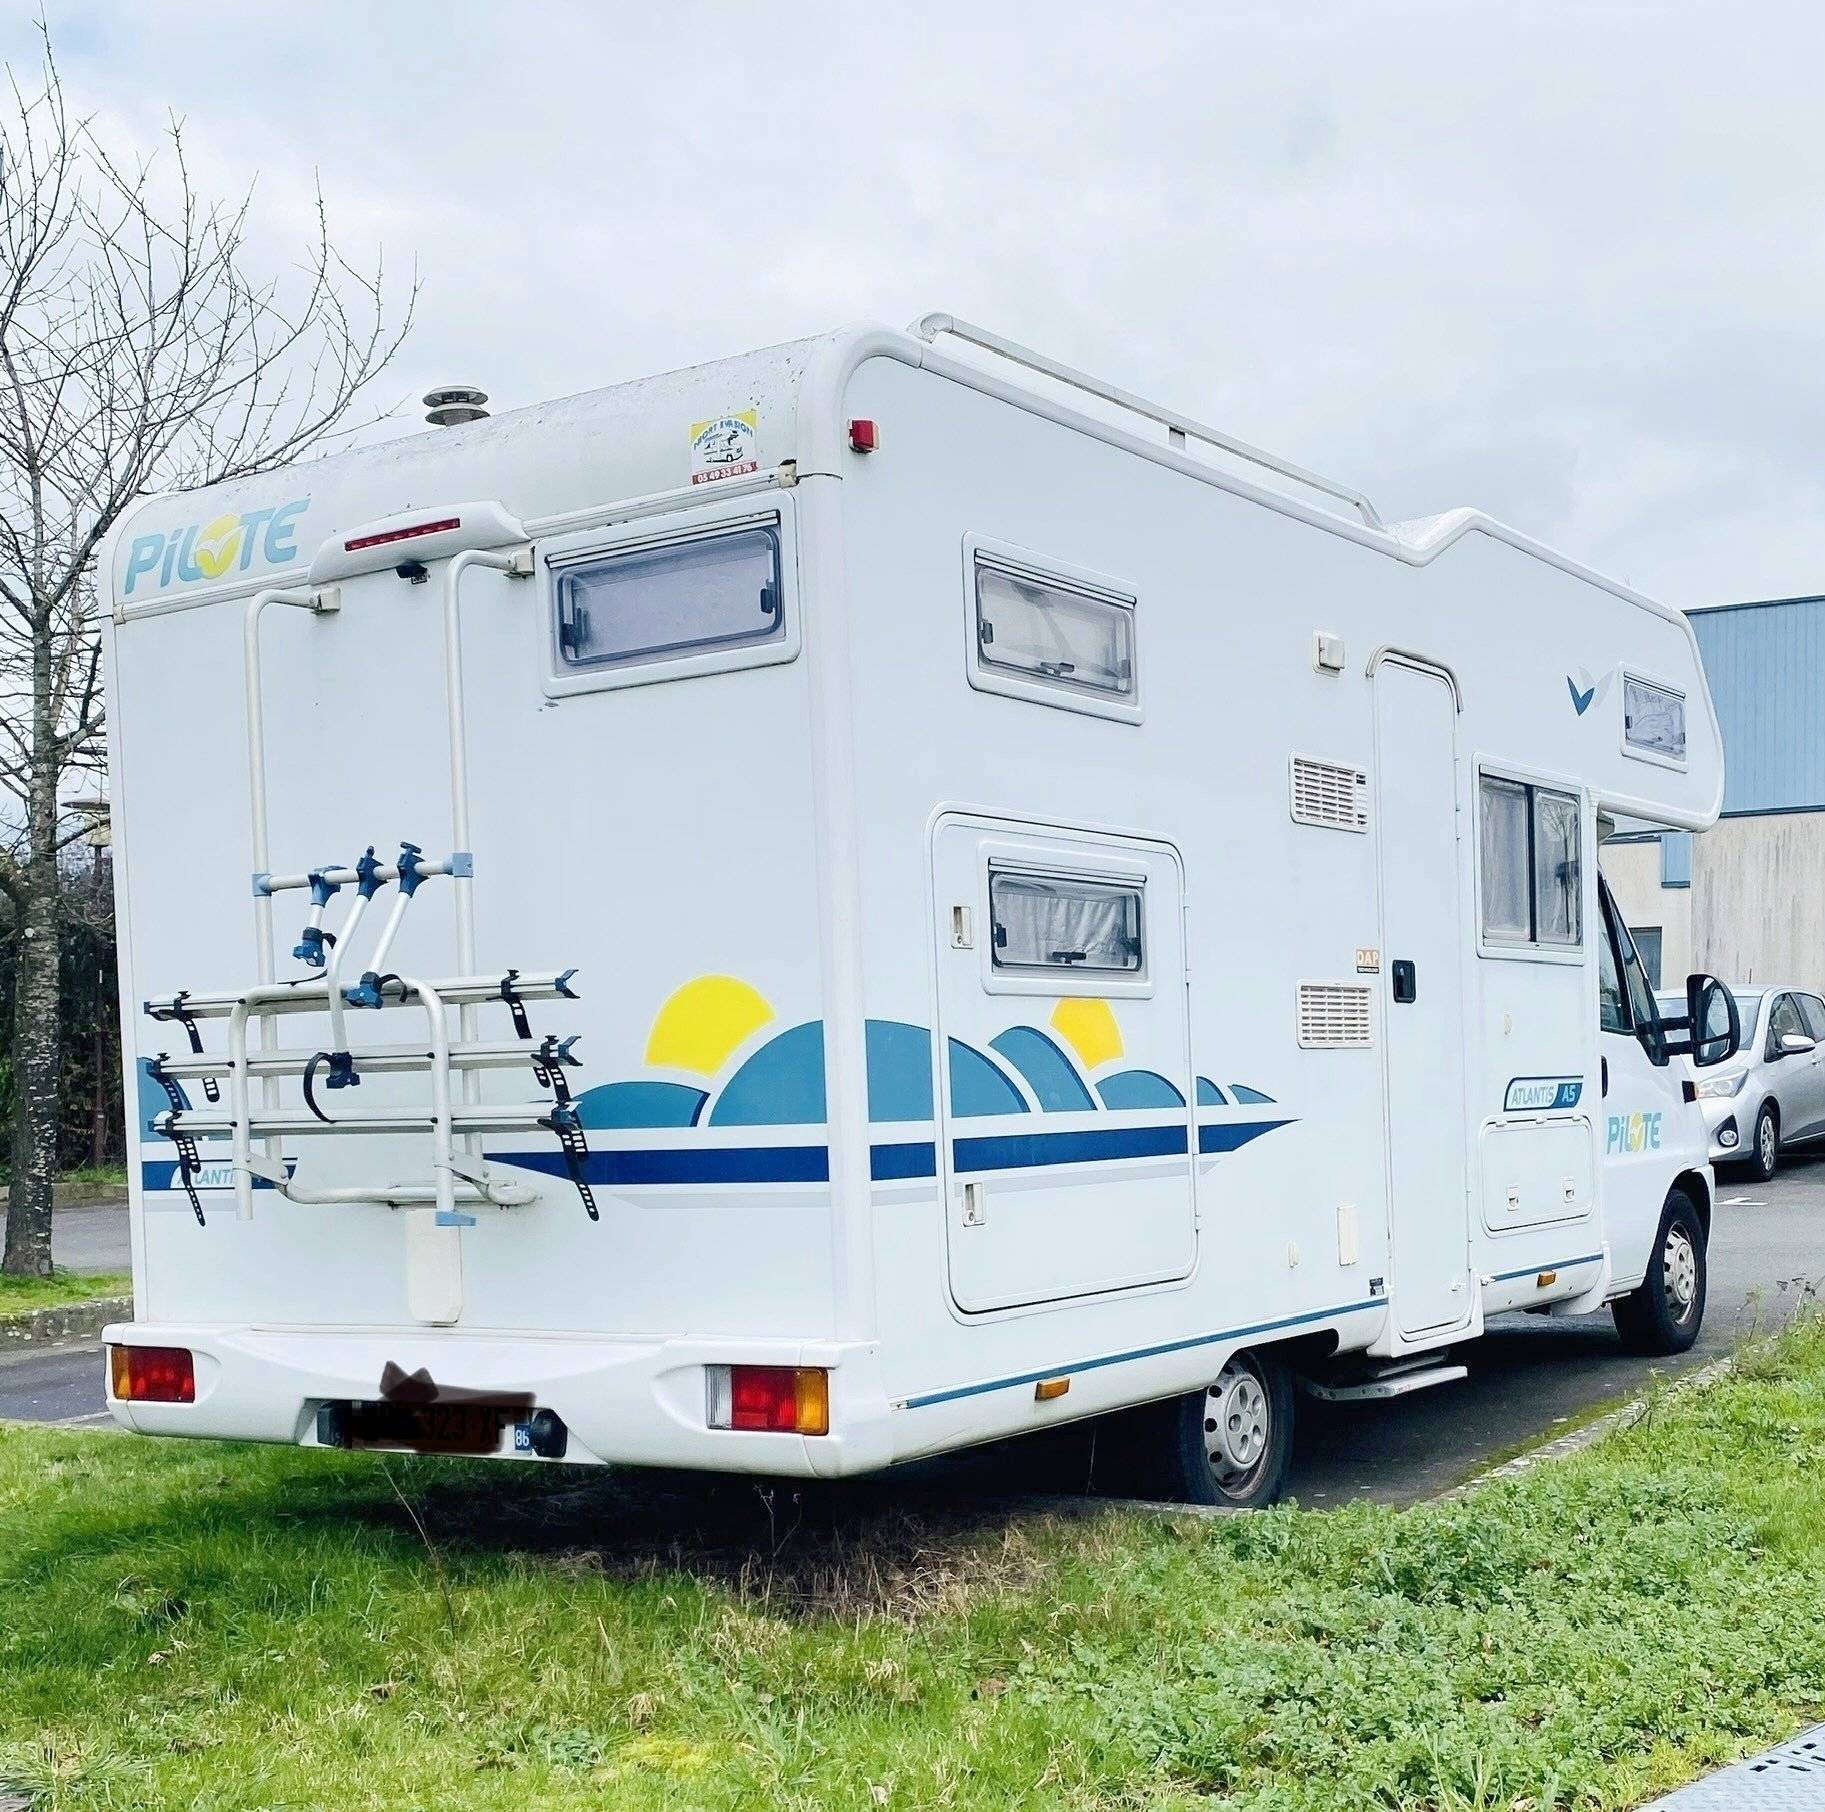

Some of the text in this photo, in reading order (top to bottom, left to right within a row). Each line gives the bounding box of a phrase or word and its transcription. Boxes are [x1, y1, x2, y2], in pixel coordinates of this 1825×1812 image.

[697, 474, 708, 483] 05
[709, 470, 720, 480] 49
[720, 467, 732, 477] 33
[1357, 950, 1379, 966] DAP
[515, 1429, 530, 1447] 86
